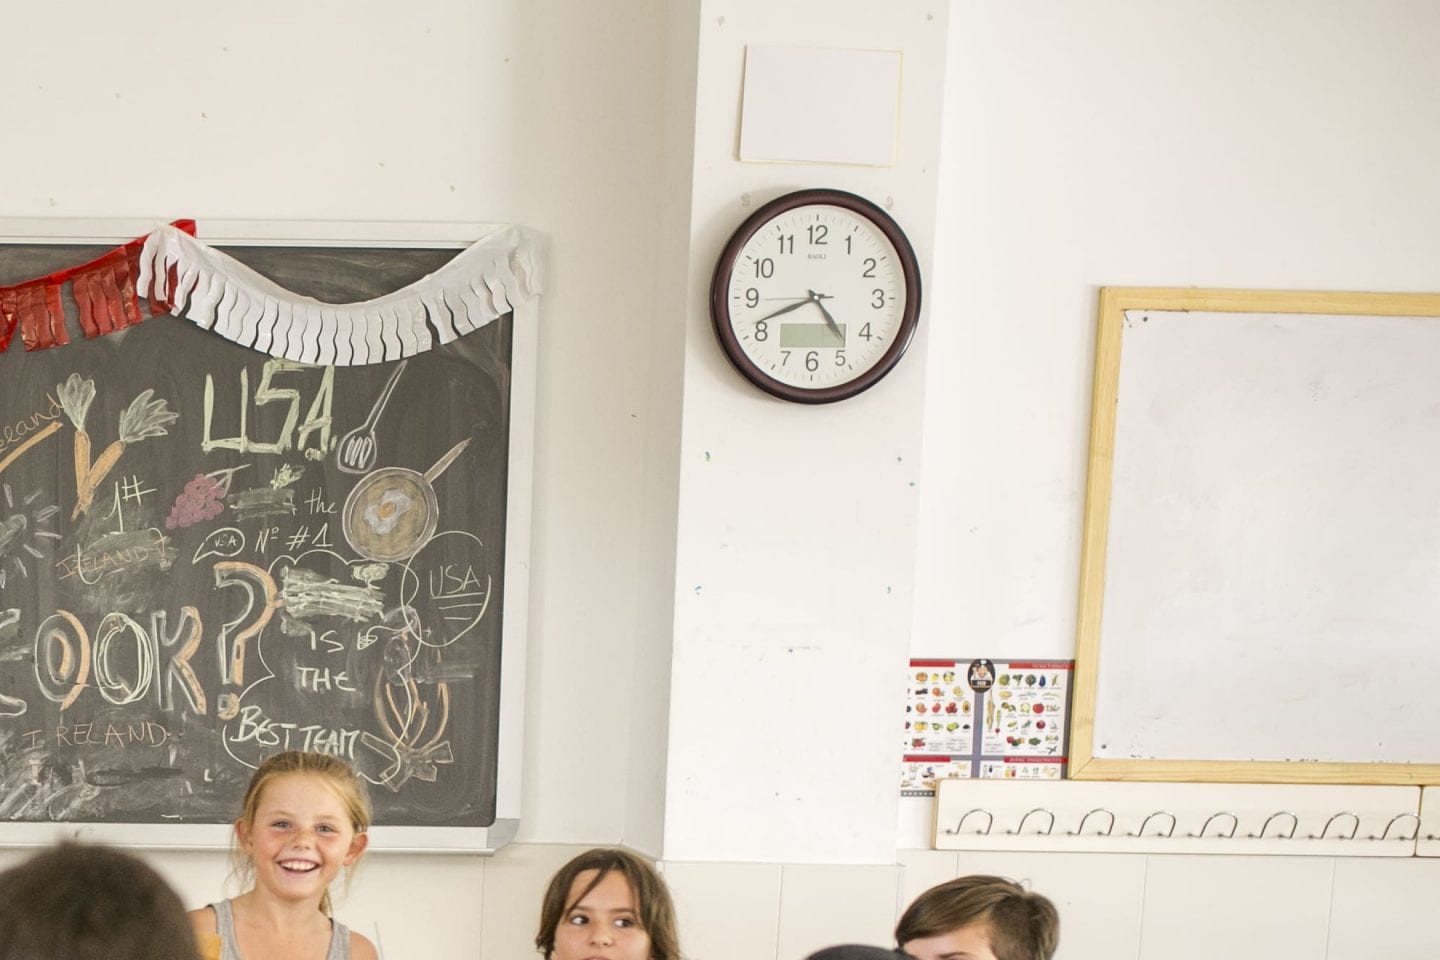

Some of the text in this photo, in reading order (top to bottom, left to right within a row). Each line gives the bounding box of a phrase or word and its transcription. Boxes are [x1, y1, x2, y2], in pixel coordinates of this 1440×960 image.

[777, 234, 794, 255] 11
[807, 224, 828, 245] 12
[844, 234, 852, 255] 1
[753, 258, 774, 279] 10
[862, 258, 878, 279] 2
[745, 287, 759, 308] 9
[871, 288, 885, 309] 3
[754, 321, 769, 342] 8
[858, 321, 873, 341] 4
[780, 350, 792, 367] 7
[805, 351, 819, 372] 6
[834, 350, 846, 367] 5
[429, 564, 482, 598] USA
[310, 630, 345, 654] IS
[296, 665, 357, 693] THE
[229, 704, 361, 761] BEST TEAM
